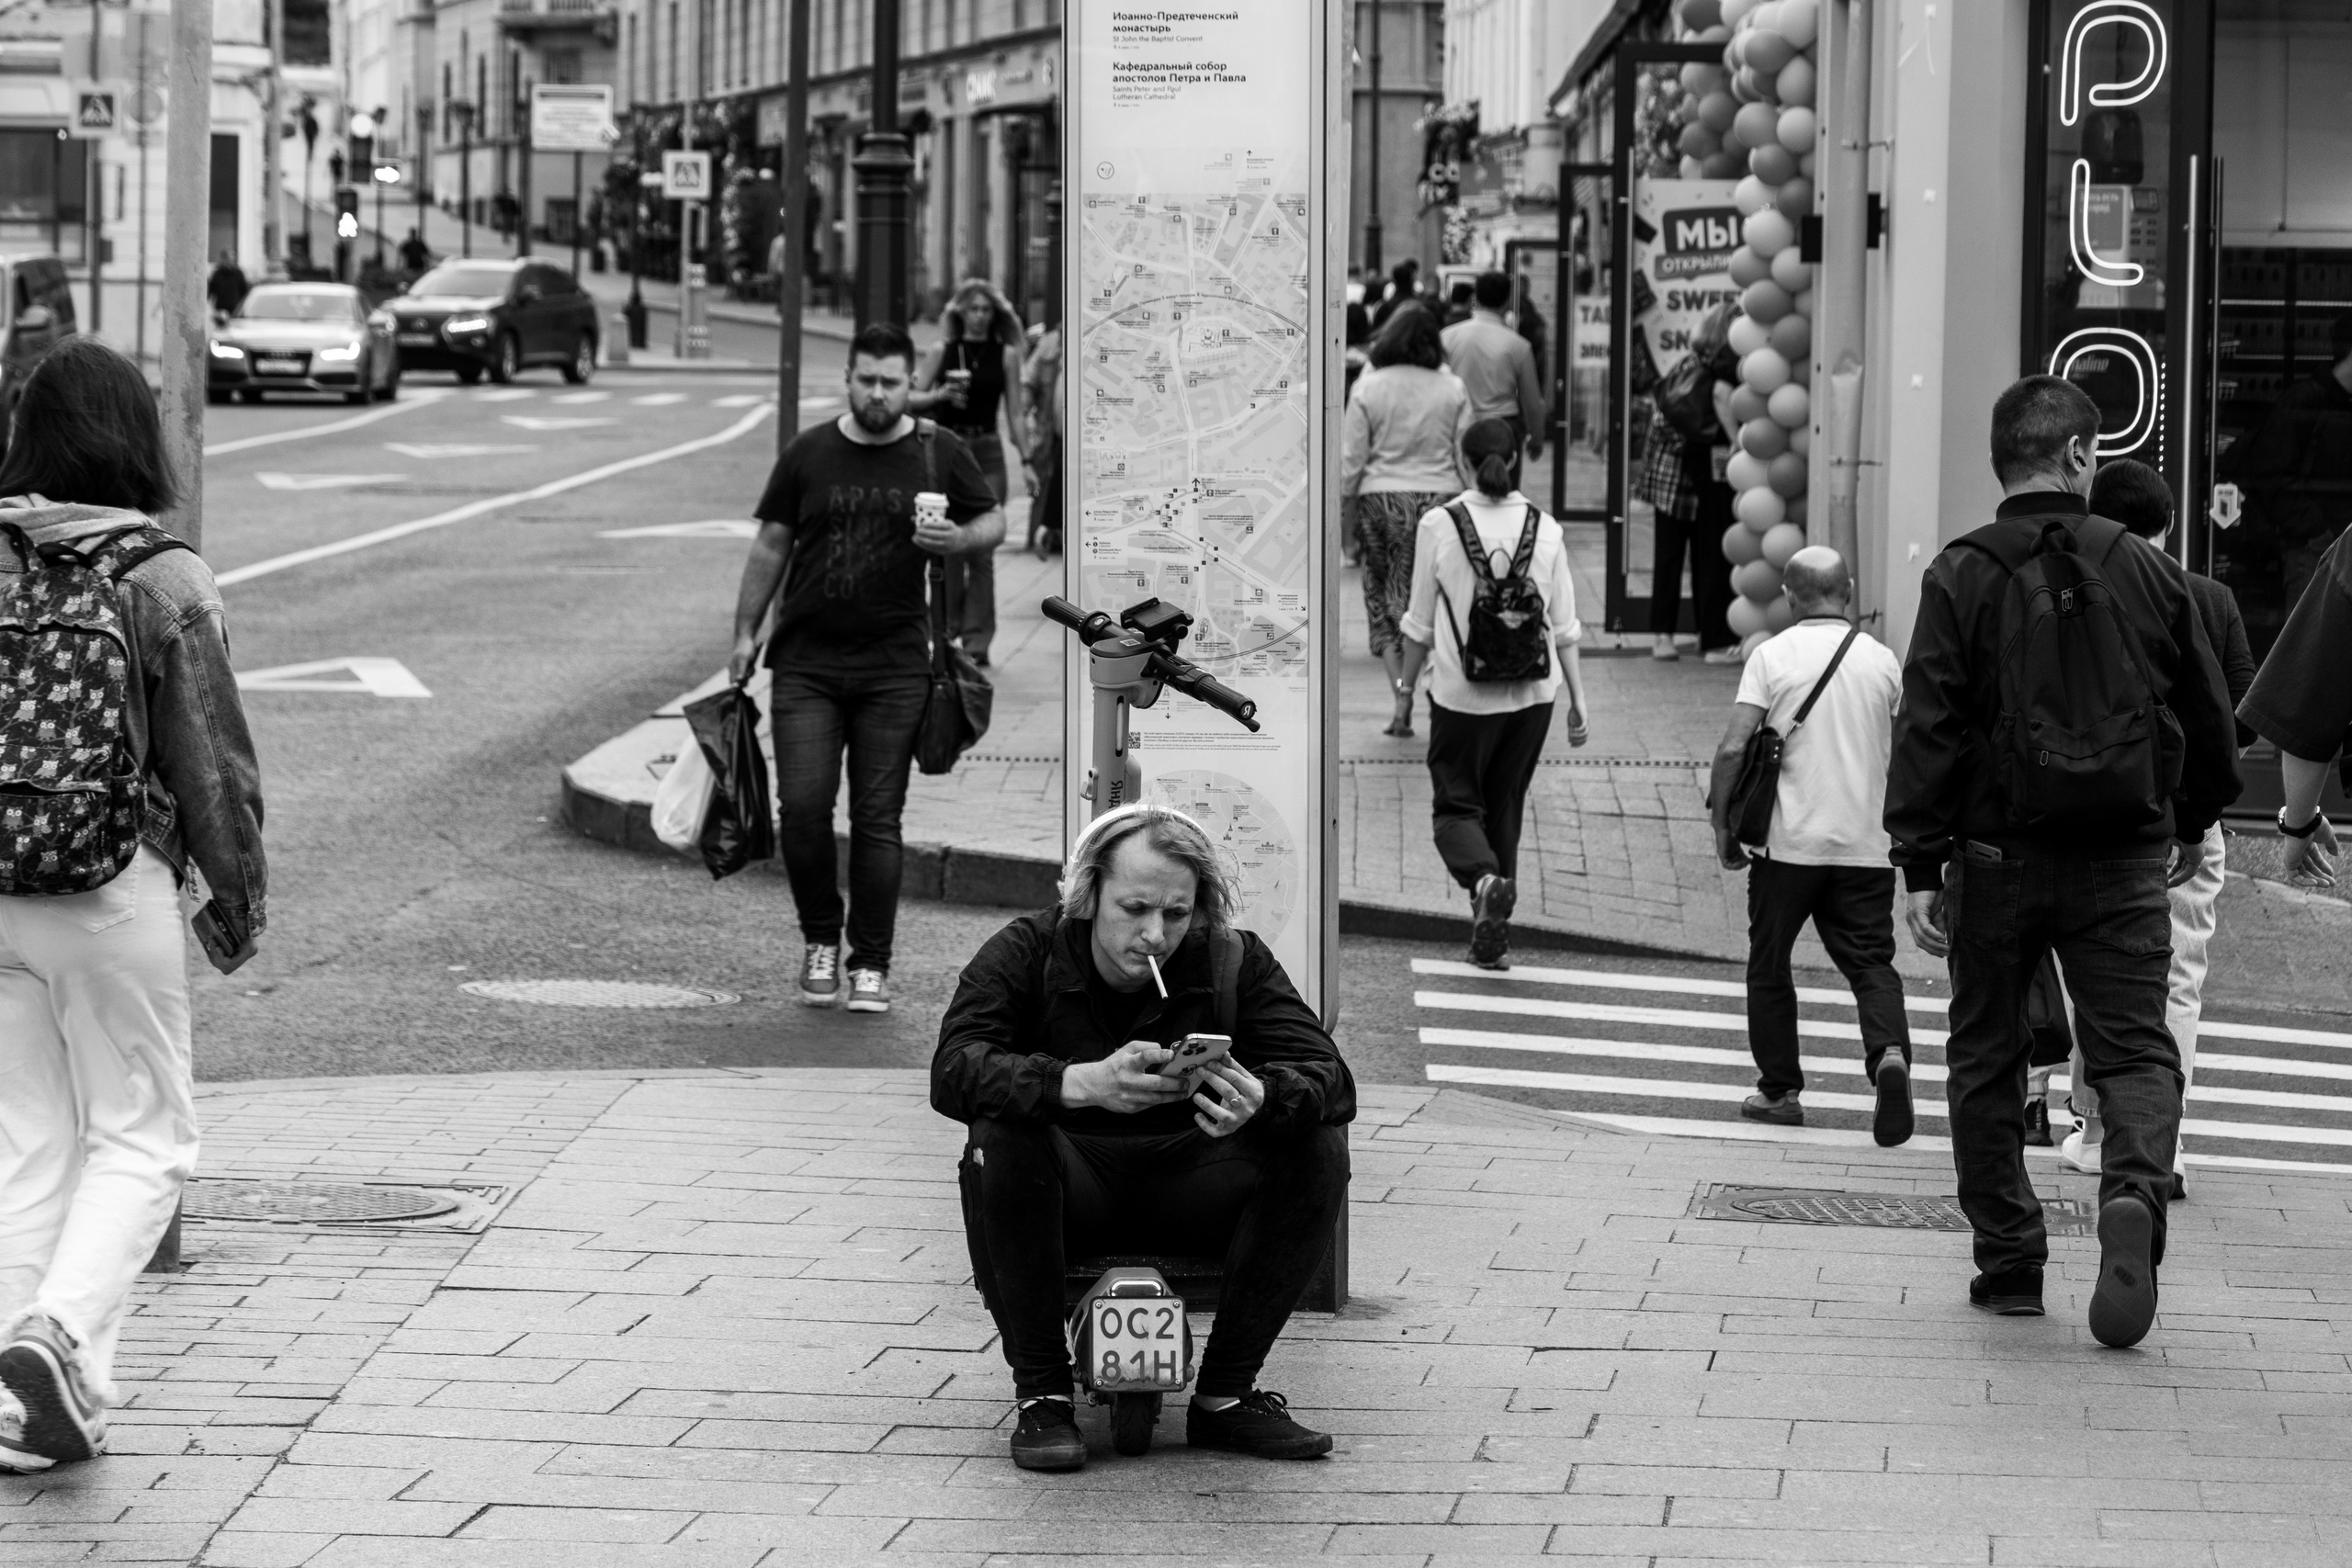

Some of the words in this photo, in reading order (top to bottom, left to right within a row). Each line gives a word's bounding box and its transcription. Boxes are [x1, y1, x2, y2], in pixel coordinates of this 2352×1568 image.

[1113, 11, 1239, 22] Иоанно-Предтеченский
[1113, 24, 1171, 34] монастырь
[1113, 62, 1193, 73] Кафедральный
[1195, 61, 1227, 73] собор
[1113, 74, 1167, 83] апостолов
[1170, 73, 1202, 85] Петра
[1204, 74, 1211, 83] и
[1214, 73, 1247, 83] Павла
[1676, 215, 1738, 252] МЫ
[1667, 289, 1743, 311] SWEE
